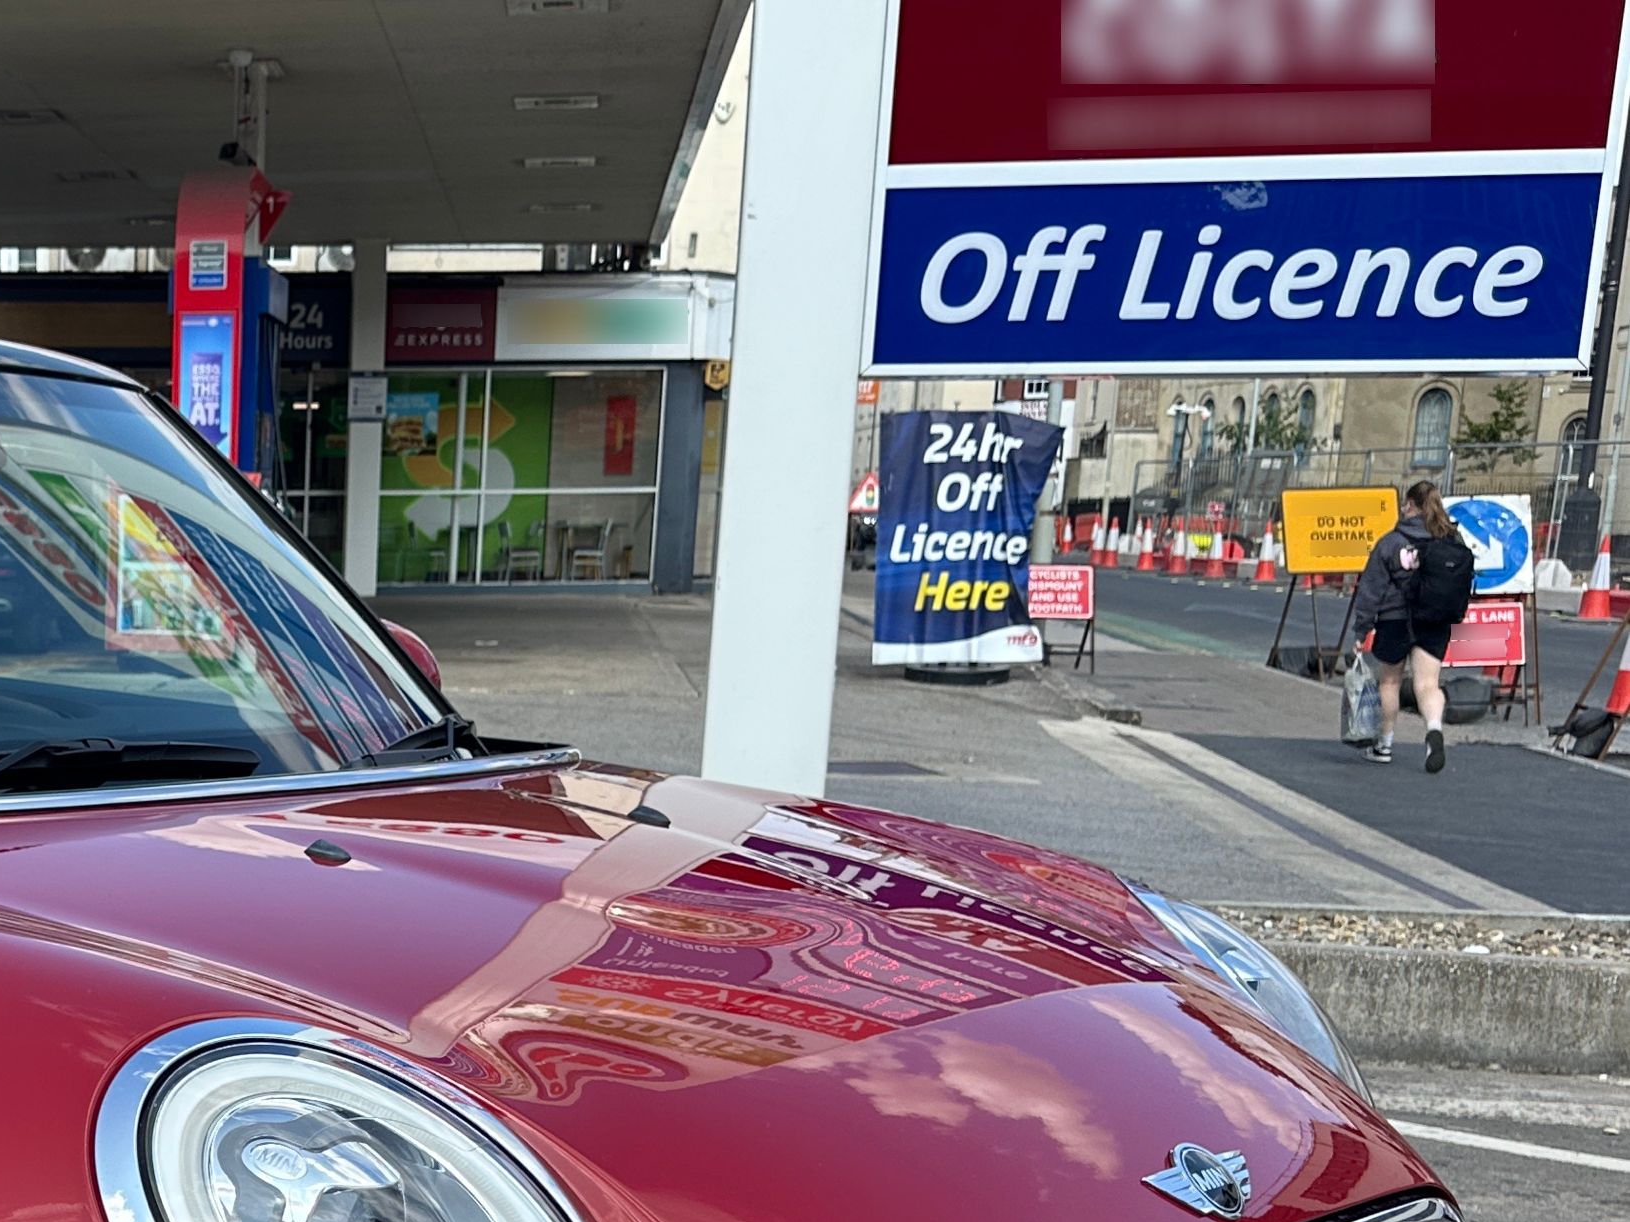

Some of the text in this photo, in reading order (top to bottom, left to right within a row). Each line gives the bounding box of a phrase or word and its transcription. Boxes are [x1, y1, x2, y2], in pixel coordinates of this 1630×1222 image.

[919, 224, 1544, 324] Off Licence
[290, 302, 324, 329] 24
[279, 331, 333, 350] Hours
[405, 333, 483, 347] EXPRESS
[923, 422, 1023, 464] 24hr
[936, 472, 1003, 512] Off
[1317, 516, 1365, 528] DO NOT
[890, 523, 1027, 565] Licence
[1310, 531, 1374, 542] OVERTAKE
[1030, 571, 1080, 580] CYCLISTS
[914, 571, 1010, 611] Here
[1029, 581, 1084, 591] DISMOUNT
[1031, 592, 1079, 602] AND USE
[1029, 603, 1083, 613] FOOTPATH
[1481, 610, 1515, 622] LANE
[1192, 1166, 1233, 1192] MINI
